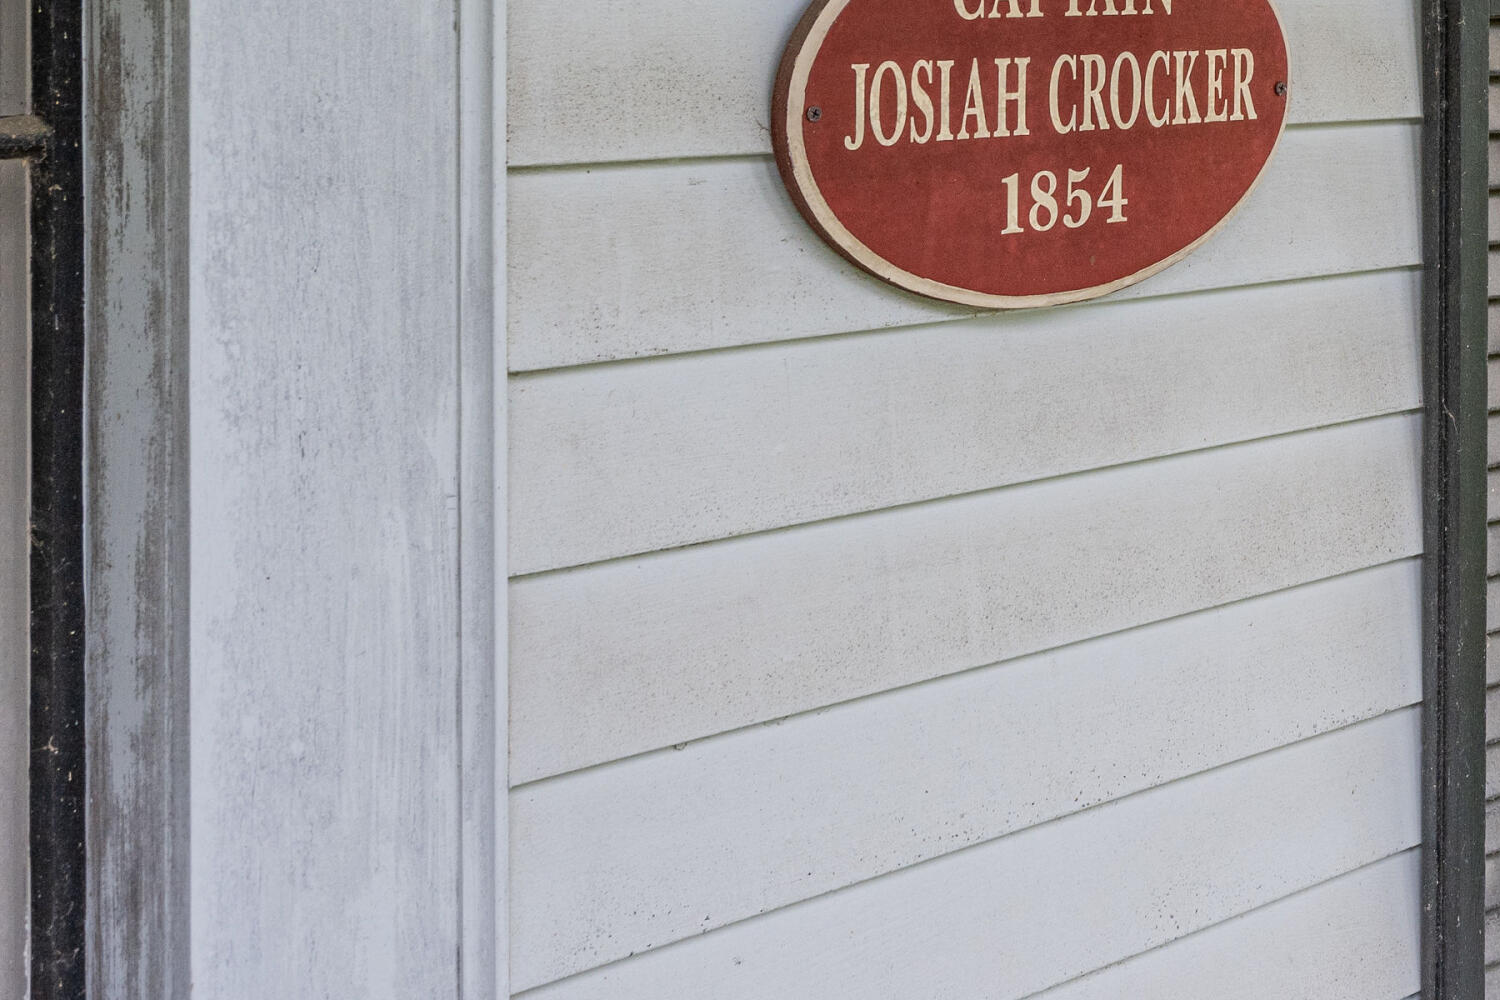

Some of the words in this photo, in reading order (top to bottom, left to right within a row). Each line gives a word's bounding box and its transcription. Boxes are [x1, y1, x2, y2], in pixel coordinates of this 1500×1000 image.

[843, 56, 1031, 151] JOSIAH
[1049, 47, 1259, 135] CROCKER
[1000, 163, 1129, 235] 1854
